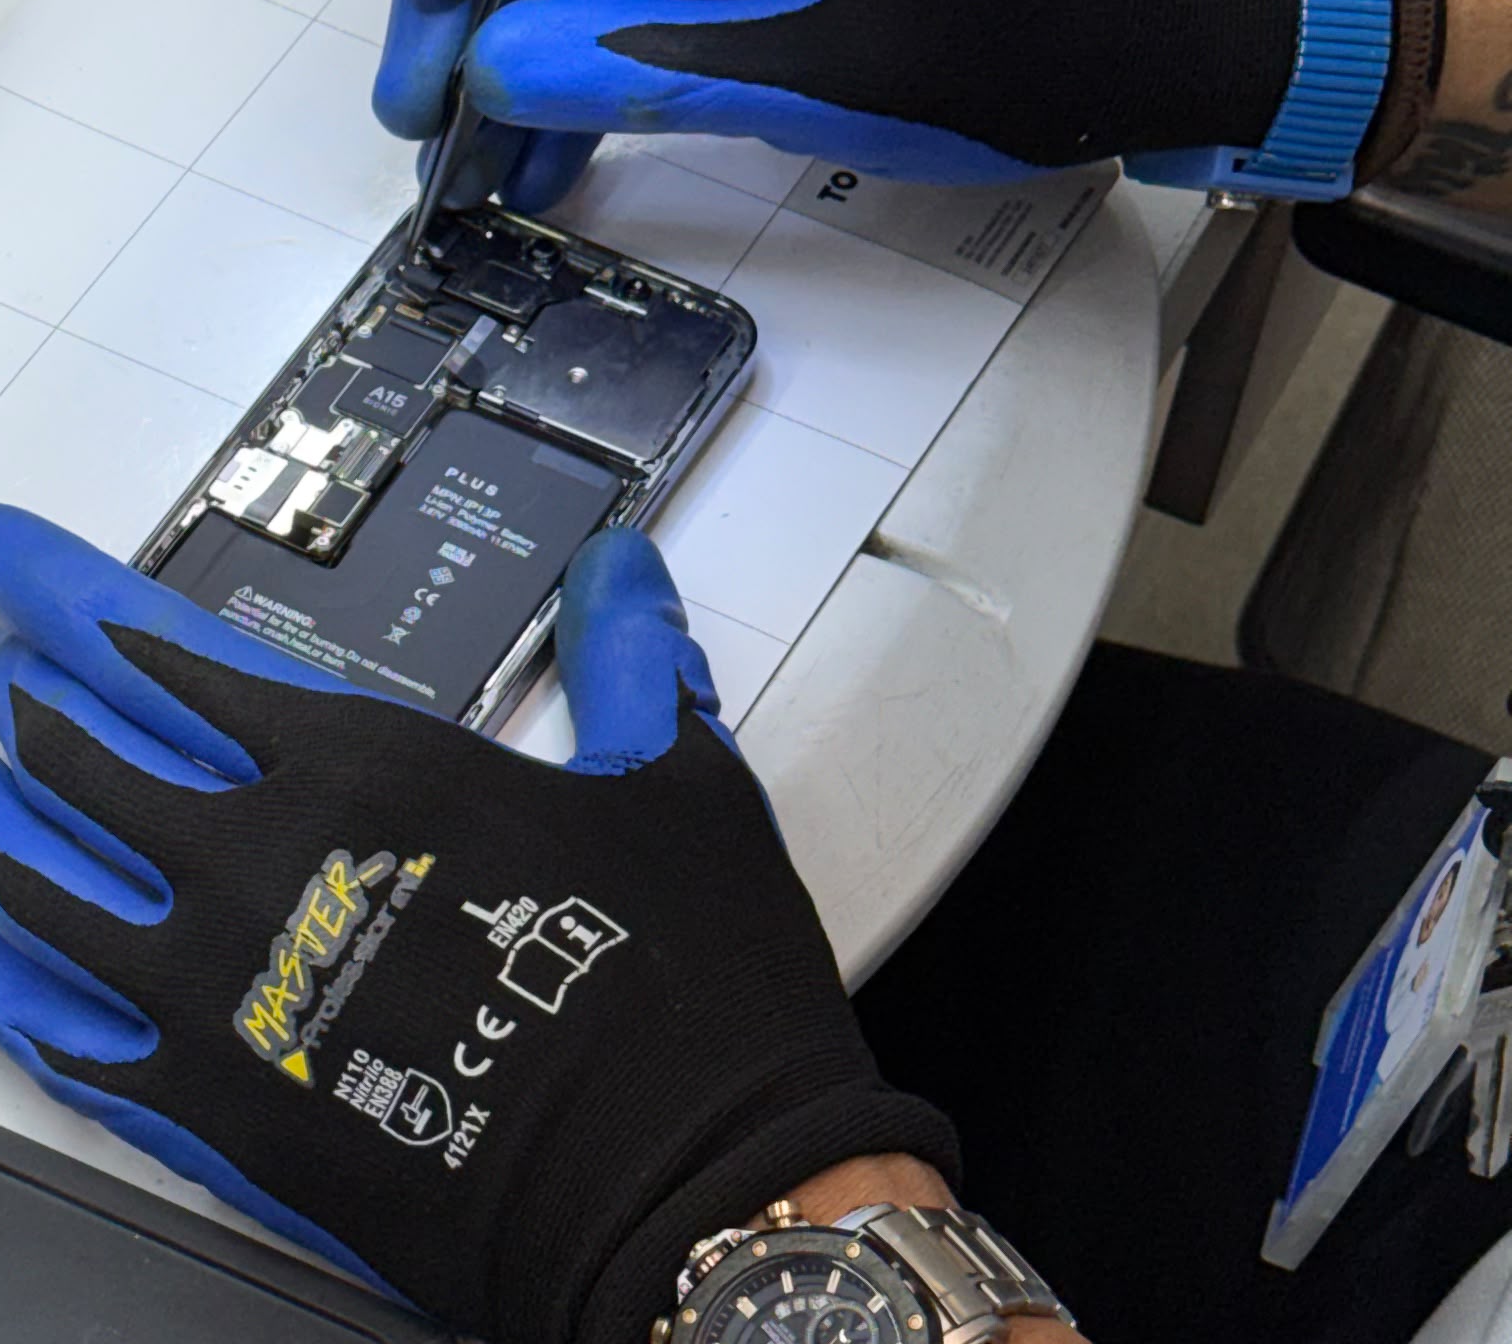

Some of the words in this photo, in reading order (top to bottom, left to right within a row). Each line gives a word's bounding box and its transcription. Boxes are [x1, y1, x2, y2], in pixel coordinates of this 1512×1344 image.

[817, 170, 859, 203] TO
[368, 385, 408, 408] A15
[444, 466, 499, 497] PLUS
[460, 900, 512, 926] L
[487, 896, 539, 949] EN420
[241, 858, 382, 1053] MASTER
[454, 1004, 517, 1077] CE
[349, 1058, 385, 1111] Nitrilo
[363, 1067, 404, 1120] EN388
[443, 1103, 491, 1169] 4121X
